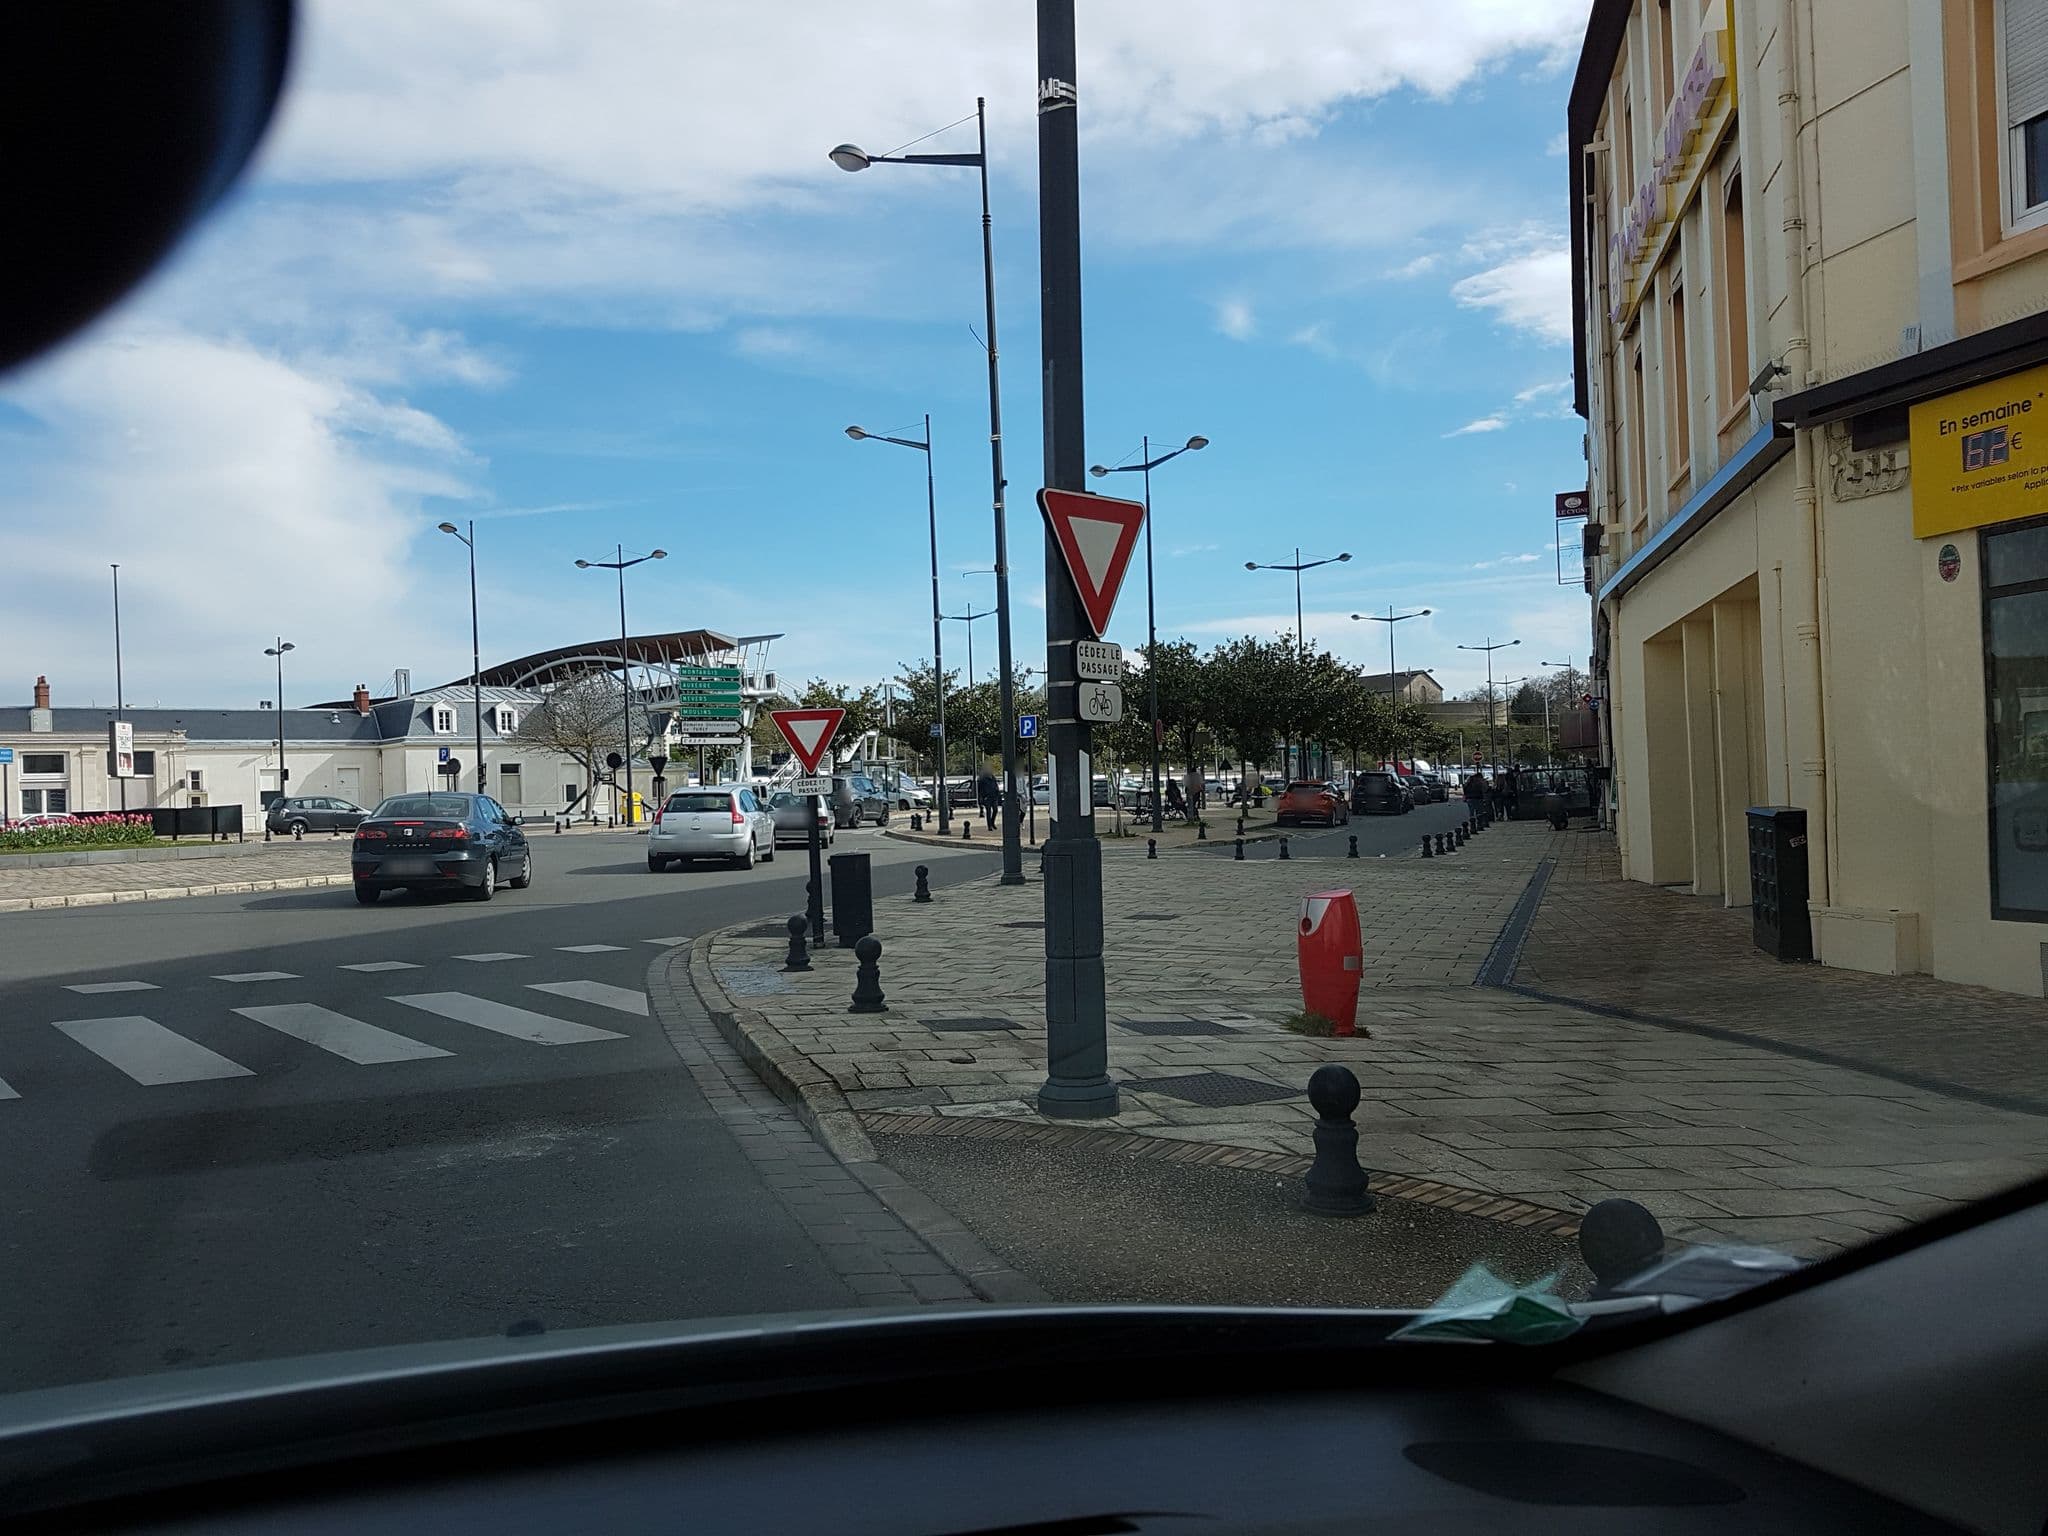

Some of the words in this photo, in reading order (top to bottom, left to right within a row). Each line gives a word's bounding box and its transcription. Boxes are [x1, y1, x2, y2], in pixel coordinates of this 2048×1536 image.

[1940, 420, 1957, 435] En
[1962, 400, 2032, 429] semaine
[1972, 475, 2006, 489] variables
[2007, 470, 2029, 481] selon
[2031, 467, 2039, 475] la
[1079, 644, 1106, 659] CÉDEZ
[1111, 649, 1120, 660] LE
[1081, 662, 1118, 675] PASSAGE
